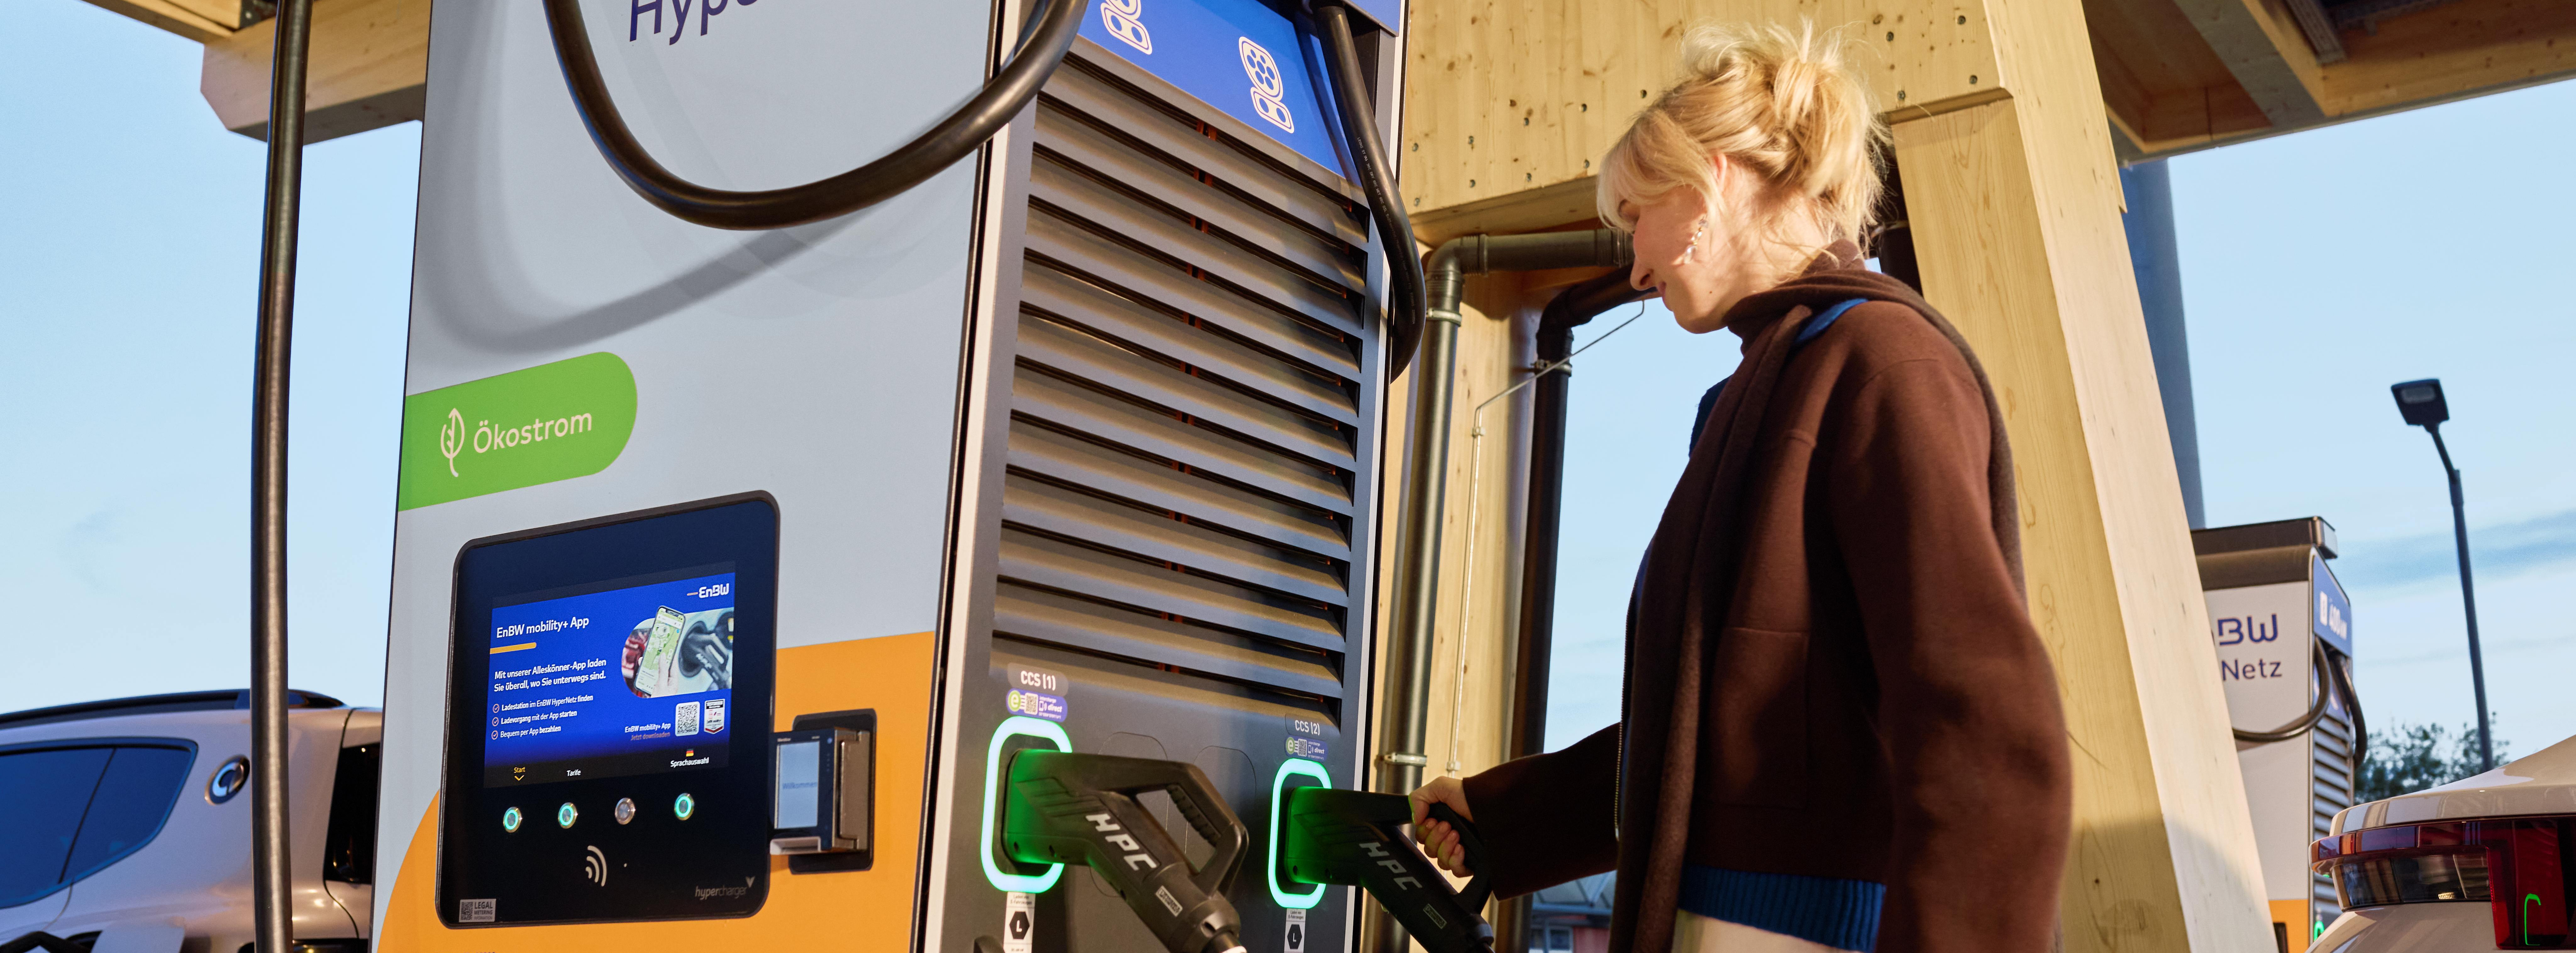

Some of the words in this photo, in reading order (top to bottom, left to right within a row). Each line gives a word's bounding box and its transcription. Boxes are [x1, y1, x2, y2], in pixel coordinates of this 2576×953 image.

[630, 0, 755, 45] Hyp
[474, 413, 592, 453] Ökostrom
[699, 583, 729, 598] EnBW
[497, 624, 525, 638] EnBW
[526, 620, 568, 634] mobility+
[570, 617, 589, 629] App
[507, 669, 531, 678] unserer
[532, 661, 586, 675] Alleskönner-App
[587, 658, 606, 668] laden
[2221, 659, 2282, 681] Netz
[494, 684, 504, 692] Sie
[506, 680, 529, 690] überall,
[541, 678, 552, 686] Sie
[553, 674, 588, 683] unterwegs
[590, 670, 606, 680] sind.
[1021, 671, 1041, 687] CCS
[1043, 673, 1056, 691] (1)
[502, 702, 529, 711] Ladestation
[537, 699, 552, 707] EnBW
[552, 697, 577, 706] HyperNetz
[1047, 704, 1062, 712] direct
[501, 715, 531, 724] Ladevorgang
[539, 725, 561, 734] bezahlen
[625, 724, 639, 733] EnBW
[1295, 720, 1309, 733] CCS
[1310, 722, 1320, 736] (2)
[670, 757, 709, 768] Sprachauswahl
[1085, 813, 1157, 871] HPC
[1359, 842, 1423, 890] HPC
[695, 885, 747, 900] hypercharger
[474, 901, 493, 909] LEGAL
[1016, 920, 1022, 932] L
[1293, 933, 1296, 942] L
